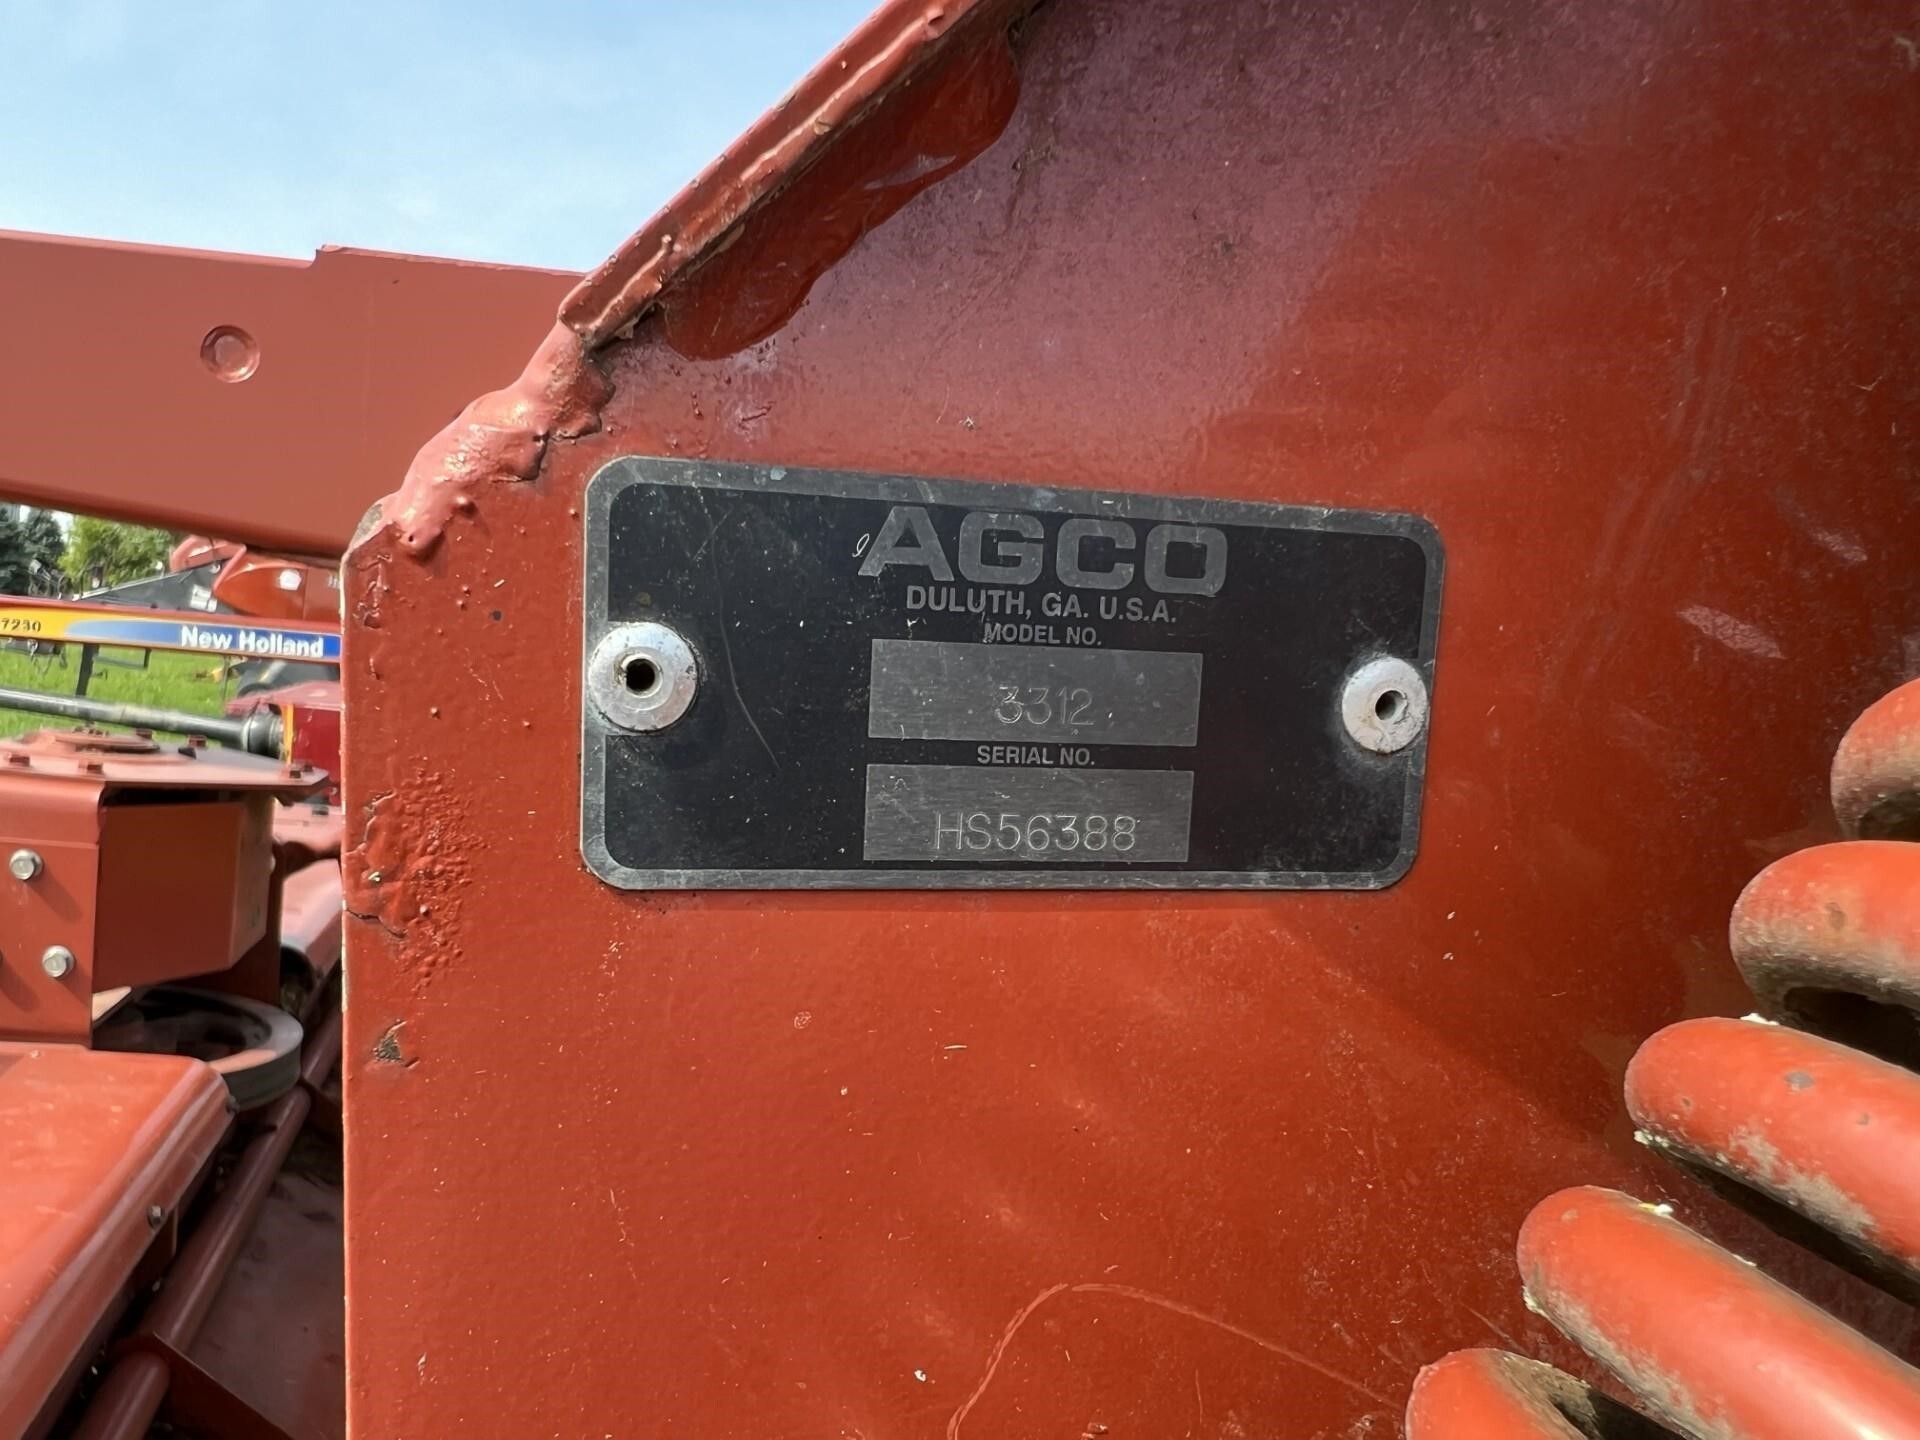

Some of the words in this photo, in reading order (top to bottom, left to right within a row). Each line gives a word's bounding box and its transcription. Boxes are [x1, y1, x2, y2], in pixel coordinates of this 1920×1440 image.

[858, 506, 1229, 597] AGCO
[906, 585, 1031, 618] DULUTH,
[1041, 592, 1089, 618] GA.
[1099, 596, 1177, 623] U.S.A.
[180, 625, 234, 648] New
[239, 630, 324, 657] Holland
[984, 623, 1060, 644] MODEL
[1066, 626, 1102, 646] NO.
[995, 685, 1095, 726] 3312
[976, 746, 1054, 765] SERIAL
[1060, 748, 1096, 767] NO.
[935, 811, 1137, 852] HS56388
